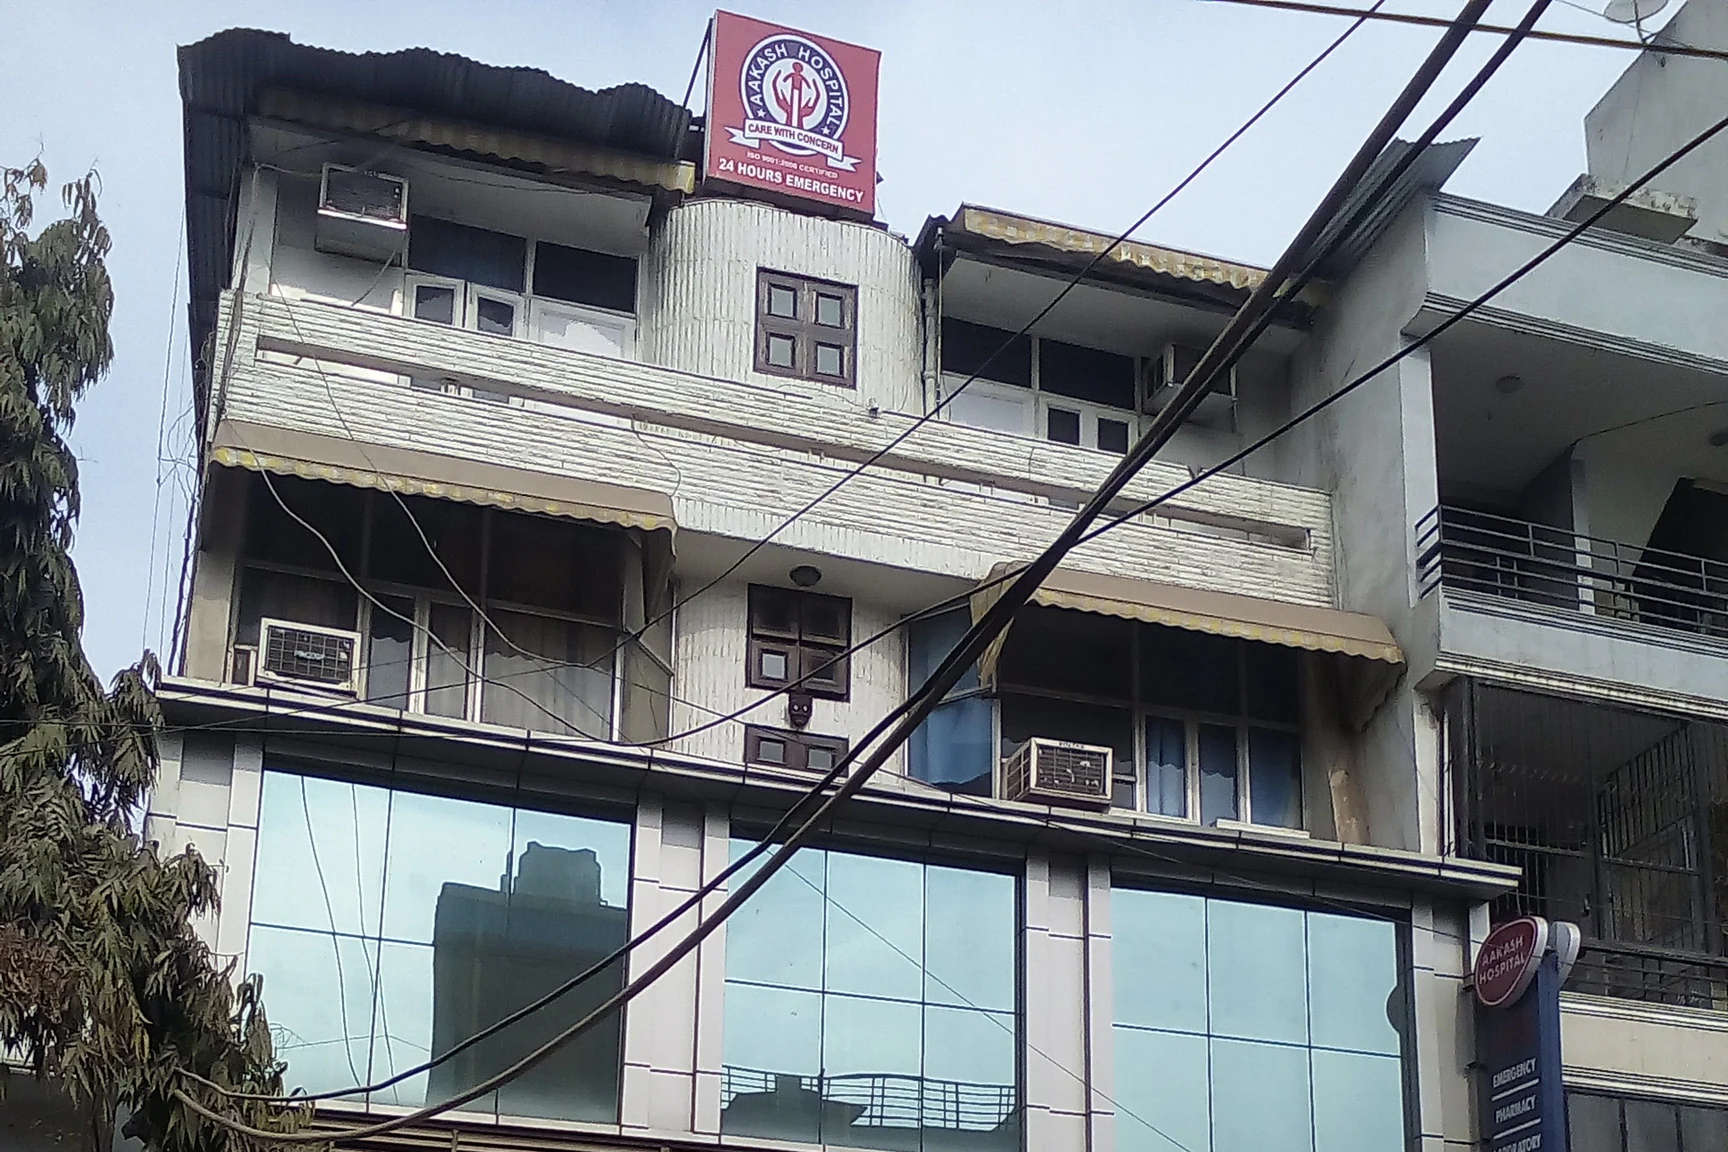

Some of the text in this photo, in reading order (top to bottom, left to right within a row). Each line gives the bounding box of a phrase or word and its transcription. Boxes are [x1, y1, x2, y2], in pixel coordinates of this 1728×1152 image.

[748, 43, 842, 128] AAKASH HOSPITAL
[748, 123, 840, 155] CARE WITH CONCERN
[719, 158, 863, 203] 24 HOURS EMERGENCY
[1482, 935, 1523, 966] AAKASH
[1480, 952, 1525, 984] HOSPITAL
[1493, 1058, 1536, 1088] EMERGENCY
[1496, 1095, 1536, 1124] PHARMACY
